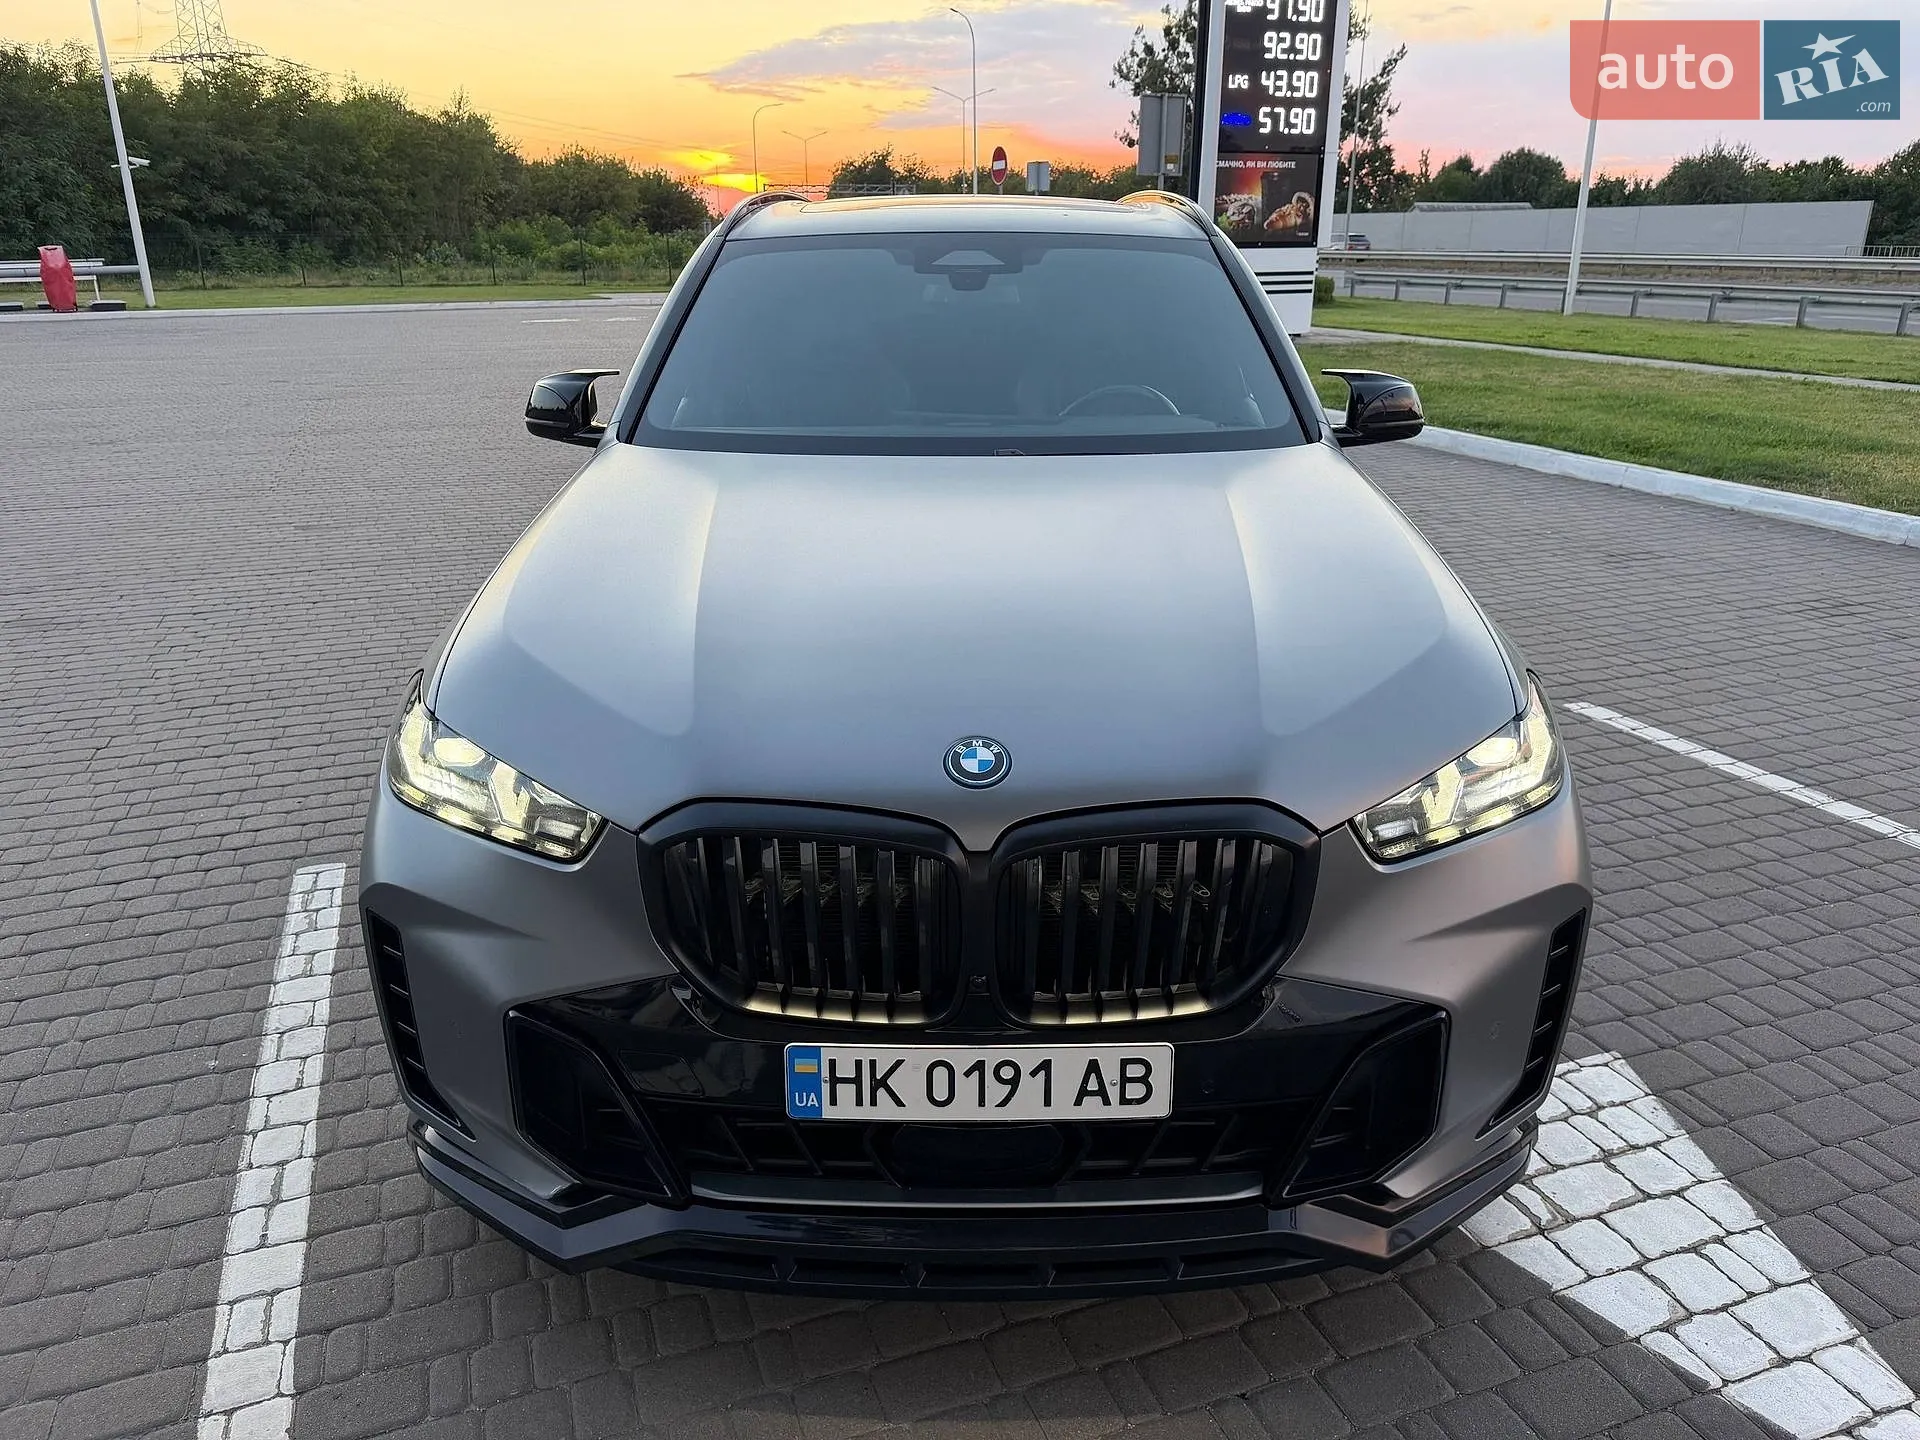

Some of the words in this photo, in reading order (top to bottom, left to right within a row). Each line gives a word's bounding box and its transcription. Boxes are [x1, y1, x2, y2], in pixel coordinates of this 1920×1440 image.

[1264, 31, 1322, 60] 92.90
[1228, 74, 1249, 89] LPG
[1260, 70, 1319, 98] 43.90
[1258, 106, 1316, 134] 57.90
[956, 740, 1001, 753] BMW
[828, 1058, 906, 1108] HK
[925, 1058, 1053, 1108] 0191
[1073, 1058, 1154, 1107] AB
[795, 1092, 819, 1108] UA
